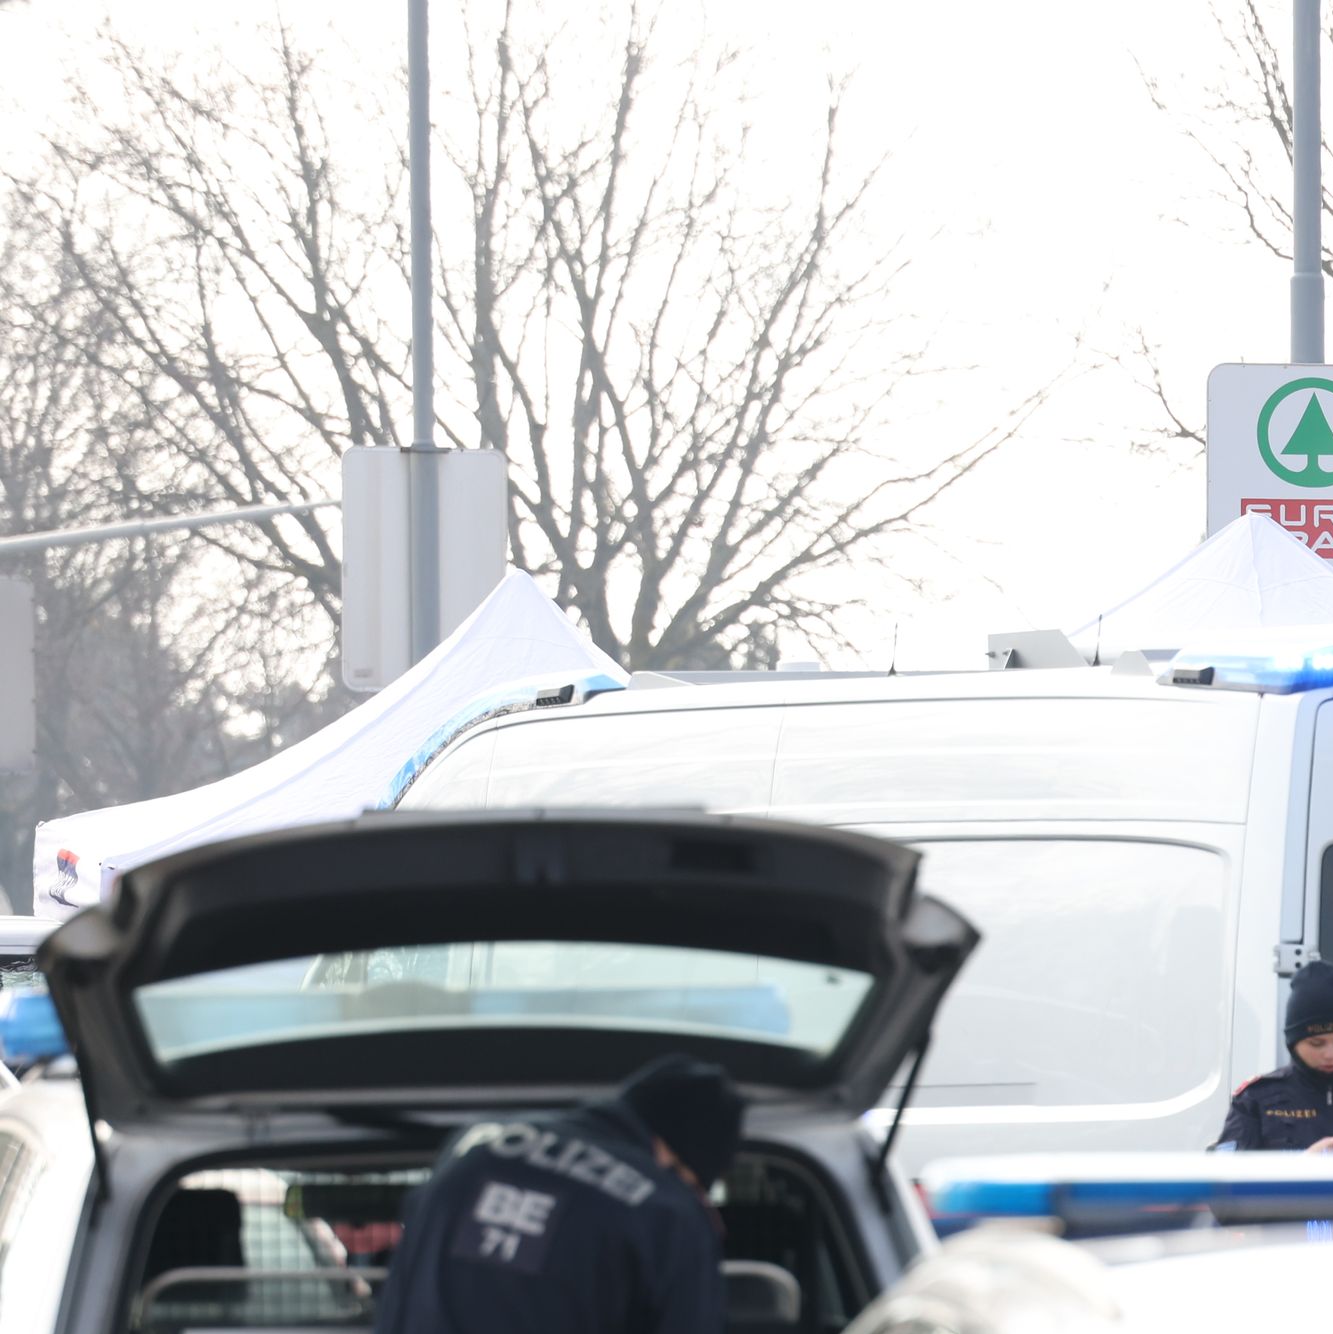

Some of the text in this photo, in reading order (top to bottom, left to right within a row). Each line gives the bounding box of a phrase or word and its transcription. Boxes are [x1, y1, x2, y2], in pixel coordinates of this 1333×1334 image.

[1265, 1108, 1318, 1119] POLIZEI
[453, 1121, 657, 1206] POLIZEI
[473, 1180, 558, 1236] BE
